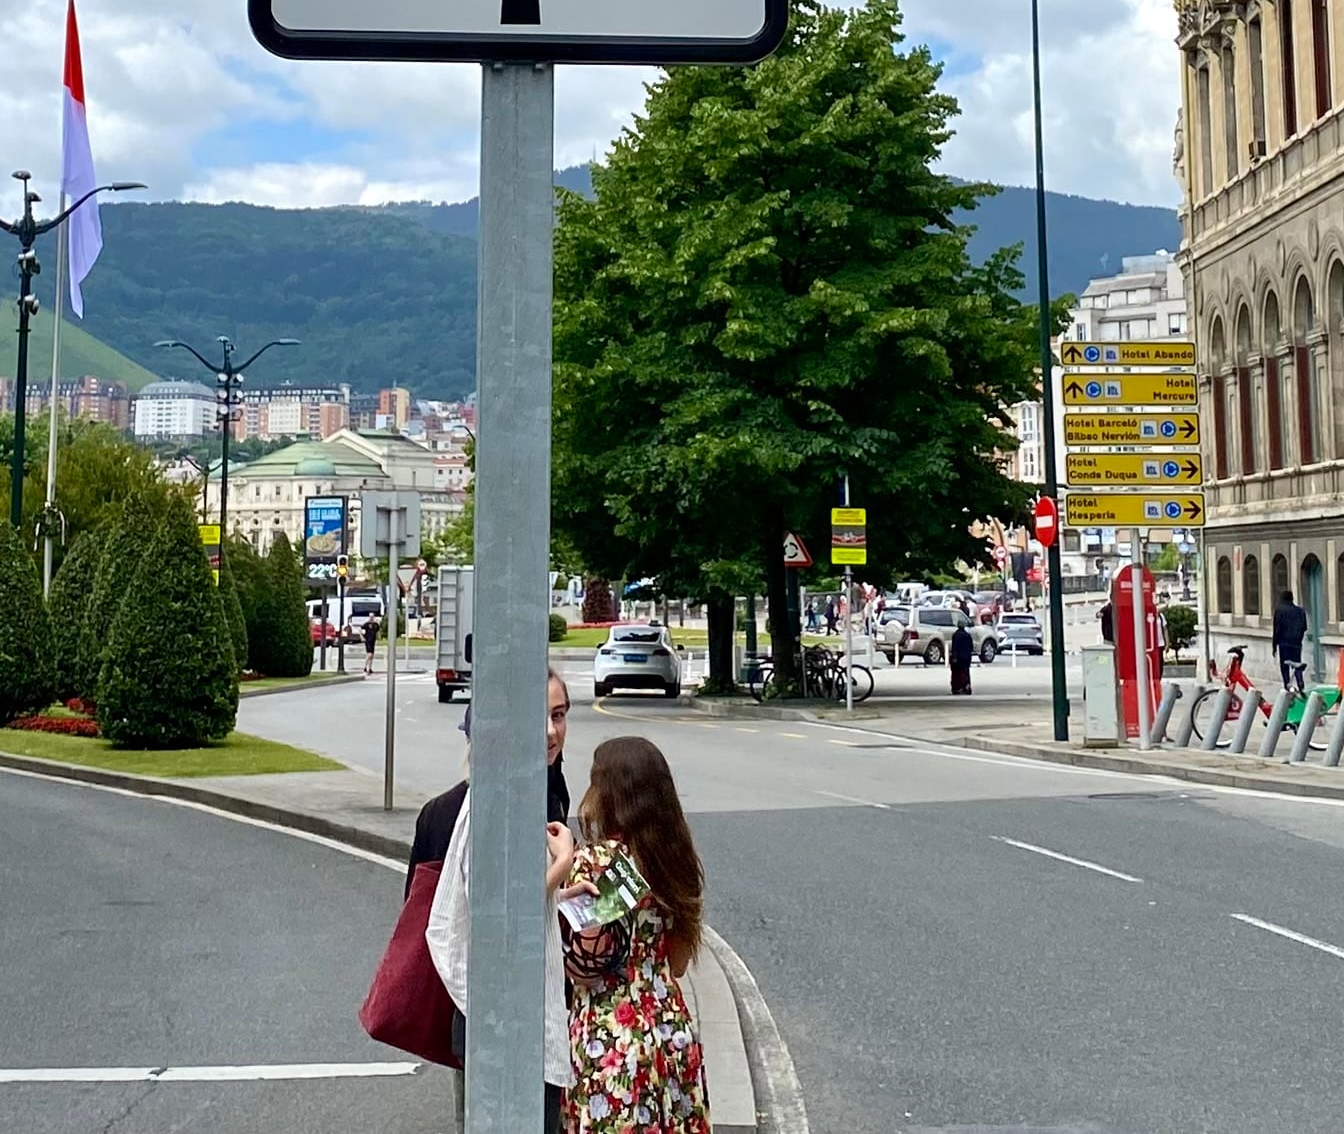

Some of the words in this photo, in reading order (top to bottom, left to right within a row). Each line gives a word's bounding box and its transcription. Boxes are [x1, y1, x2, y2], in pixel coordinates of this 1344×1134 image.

[1122, 350, 1150, 359] Hotel
[1154, 350, 1193, 359] Abando
[1166, 379, 1194, 388] Hotel
[1153, 392, 1195, 401] Mercure
[1067, 418, 1095, 428] Hotel
[1099, 418, 1137, 428] Barceló
[1067, 432, 1098, 441] Bilbao
[1101, 432, 1140, 441] Nervión
[1069, 458, 1097, 467] Hotel
[1069, 471, 1102, 479] Conde
[1105, 471, 1138, 481] Duque
[1069, 499, 1097, 507] Hotel
[1069, 511, 1115, 521] Hesperia
